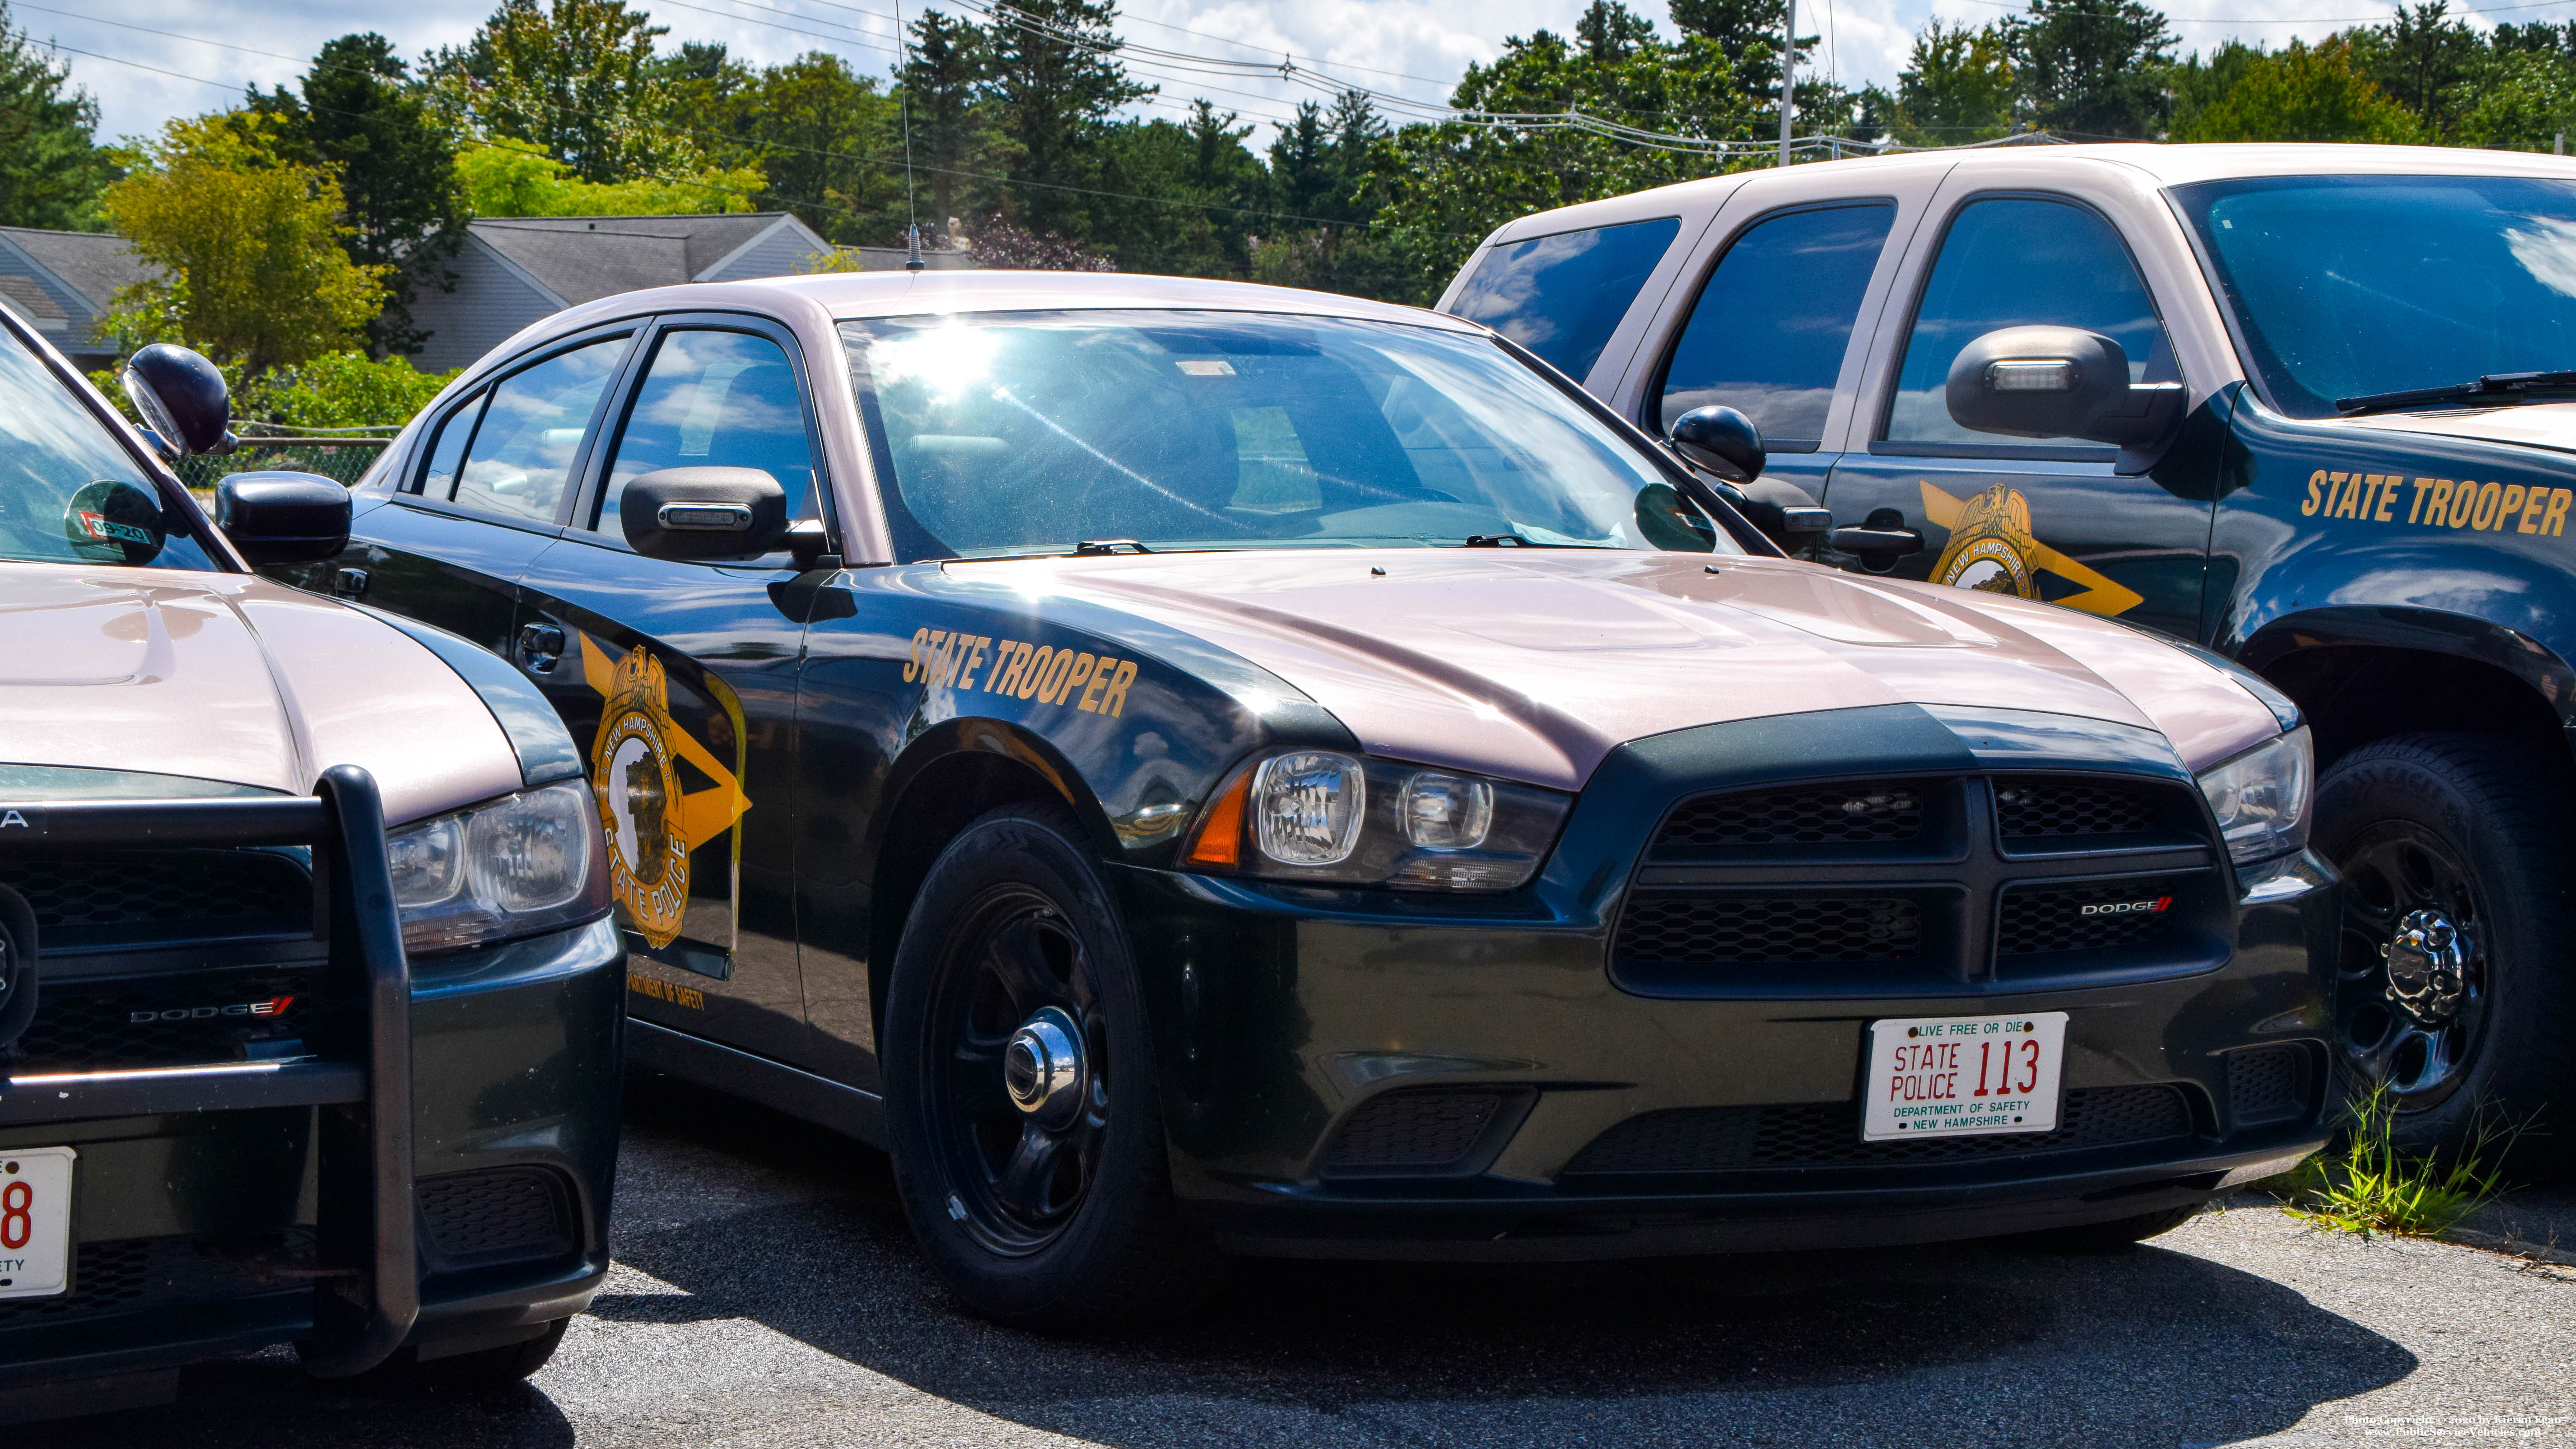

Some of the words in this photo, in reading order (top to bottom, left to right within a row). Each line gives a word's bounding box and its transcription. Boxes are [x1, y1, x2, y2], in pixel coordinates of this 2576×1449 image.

[2301, 469, 2404, 522] STATE
[2408, 477, 2573, 536] TROOPER
[91, 520, 144, 540] 09-20
[1946, 550, 1970, 584] NEW
[1972, 542, 2025, 583] HAMPSHIRE
[903, 627, 992, 690] STATE
[983, 639, 1138, 718] TROOPER
[605, 724, 622, 761] NEW
[623, 716, 666, 769] HAMPSHIRE
[605, 827, 649, 920] STATE
[651, 834, 686, 926] POLICE
[2082, 901, 2161, 914] DODGE
[664, 982, 674, 1003] OF
[675, 985, 704, 1011] SAFETY
[131, 1002, 274, 1023] DODGE
[1919, 1025, 1943, 1036] LIVE
[1949, 1024, 1978, 1035] FREE
[1984, 1023, 1999, 1034] OR
[2005, 1021, 2023, 1032] DIE
[1894, 1043, 1961, 1072] STATE
[1974, 1039, 2040, 1097] 113
[1890, 1072, 1958, 1102] POLICE
[1894, 1104, 1964, 1118] DEPARTMENT
[1970, 1103, 1984, 1113] OF
[1989, 1100, 2030, 1112] SAFETY
[1914, 1119, 1938, 1130] NEW
[1944, 1115, 2008, 1128] HAMPSHIRE
[0, 1180, 33, 1249] 8
